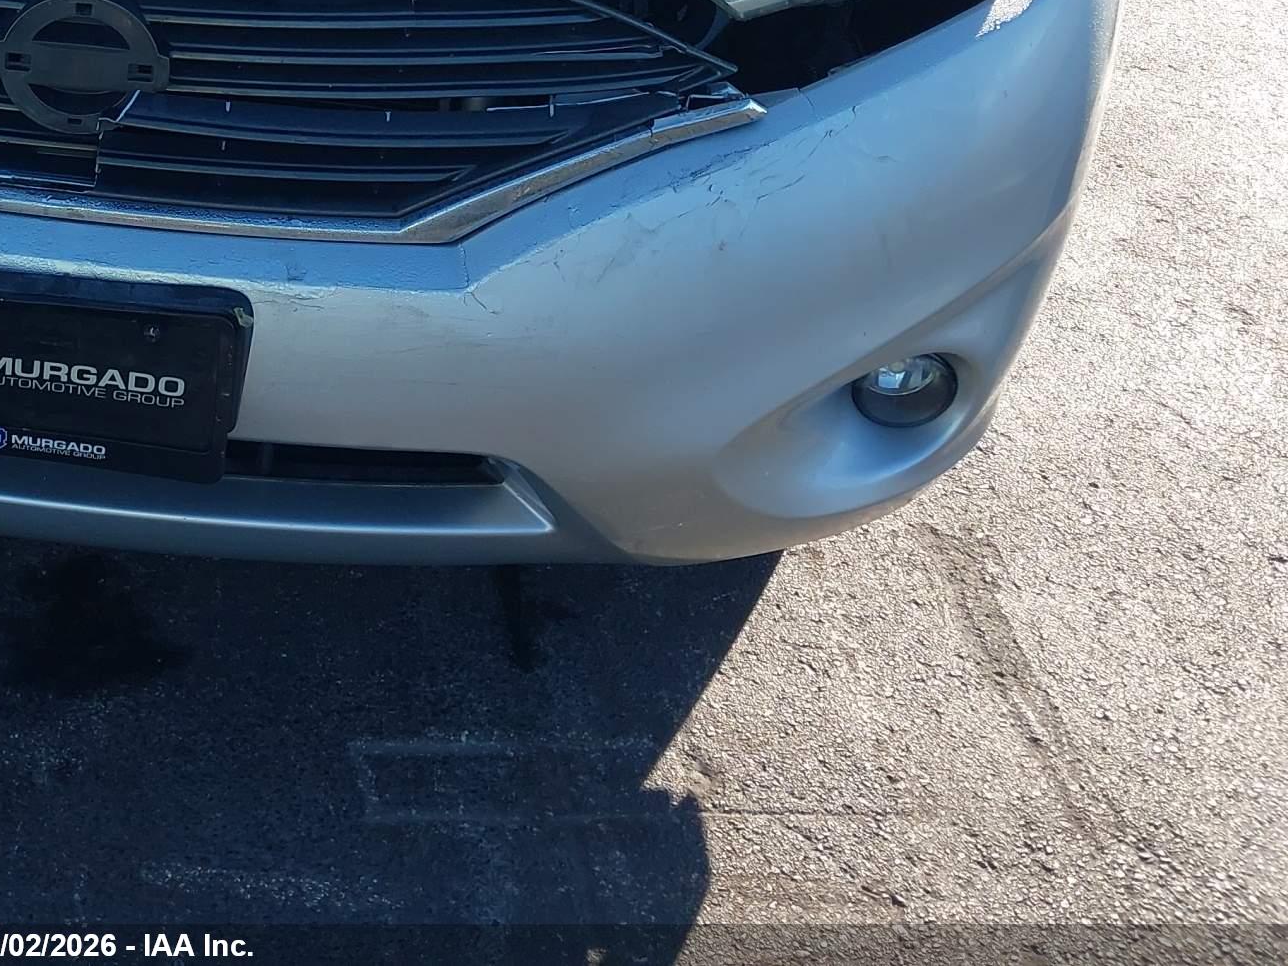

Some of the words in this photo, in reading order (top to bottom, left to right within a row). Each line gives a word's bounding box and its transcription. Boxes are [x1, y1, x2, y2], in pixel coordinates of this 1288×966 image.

[112, 389, 185, 408] GROUP
[11, 434, 106, 455] MURGADO
[11, 444, 71, 456] AUTOMOTIVE
[72, 451, 106, 460] GROUP
